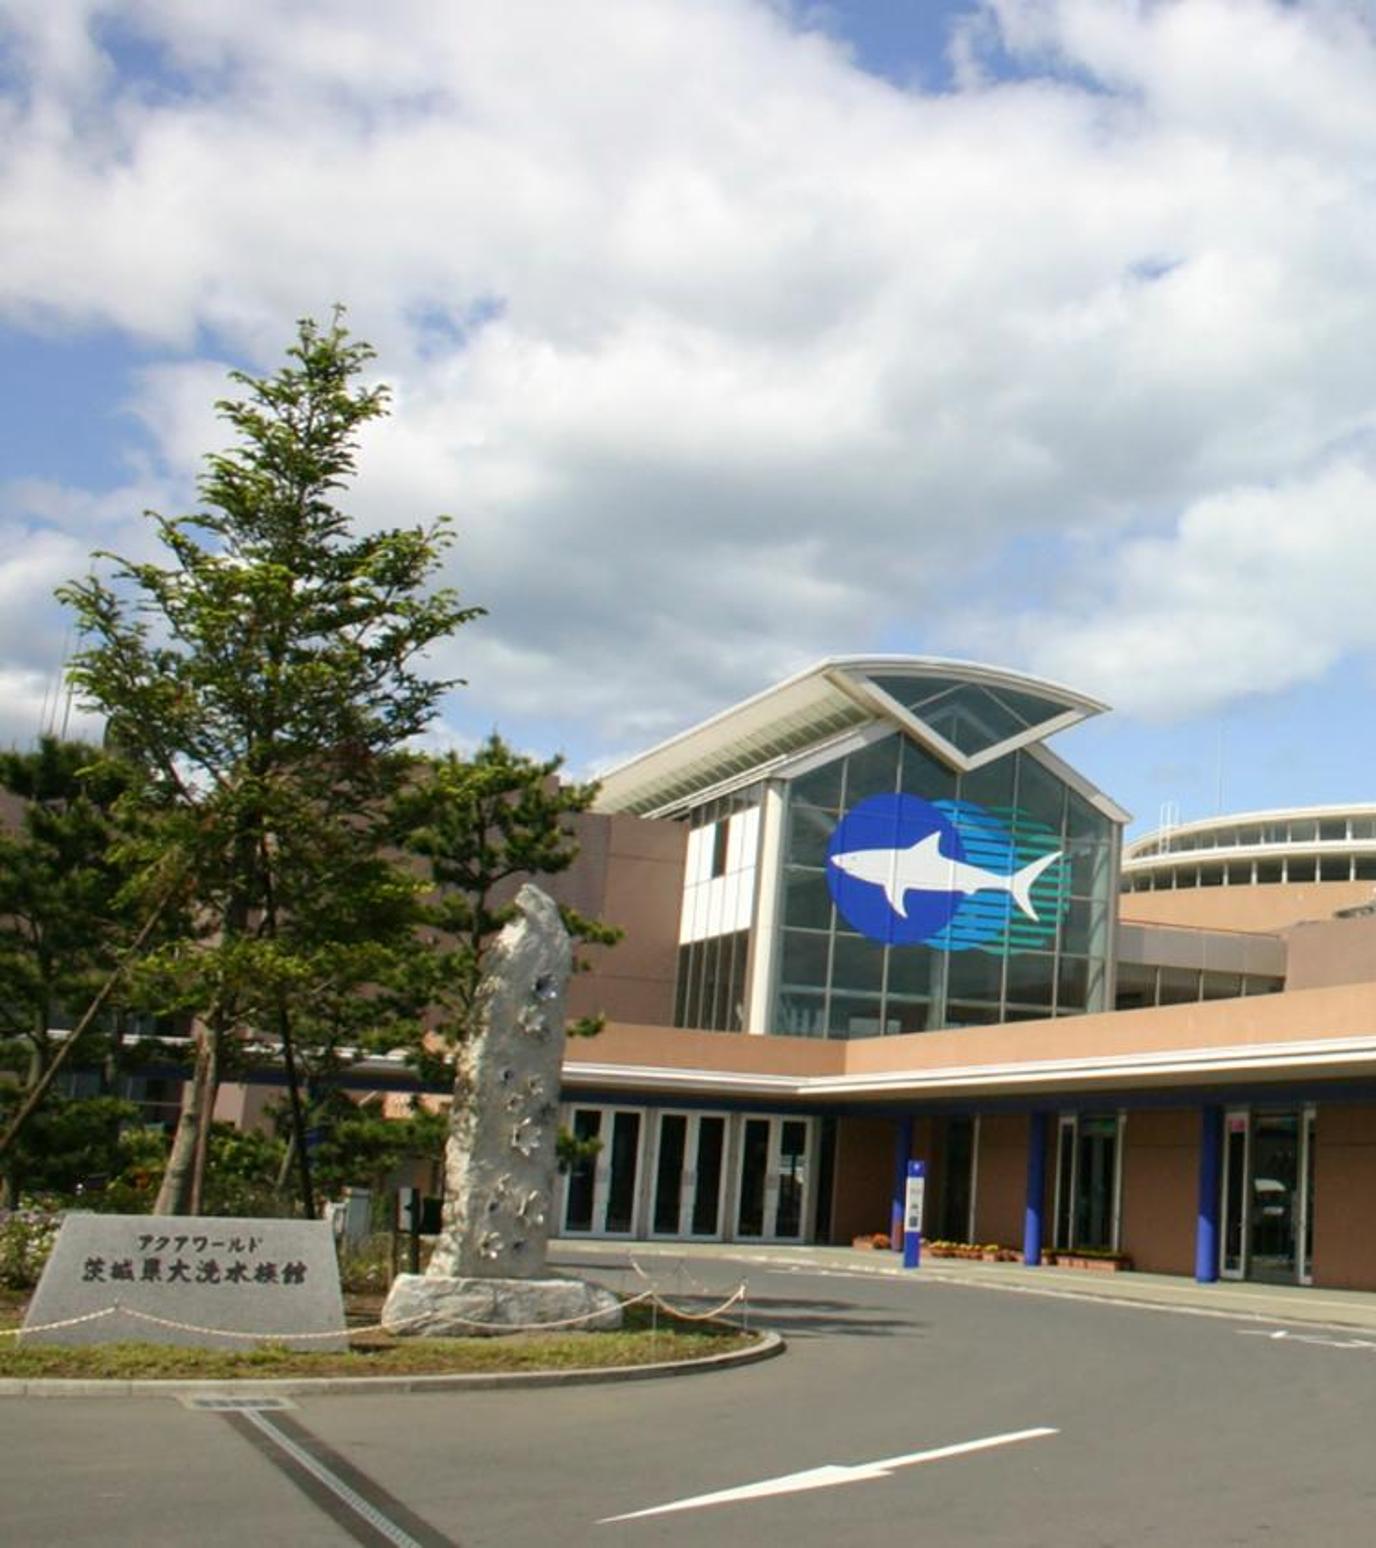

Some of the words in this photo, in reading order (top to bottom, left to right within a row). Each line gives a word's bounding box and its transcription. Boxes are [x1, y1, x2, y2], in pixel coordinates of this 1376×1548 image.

[138, 1234, 264, 1253] アクアワールド
[82, 1256, 308, 1285] 茨城県大洗水族館
